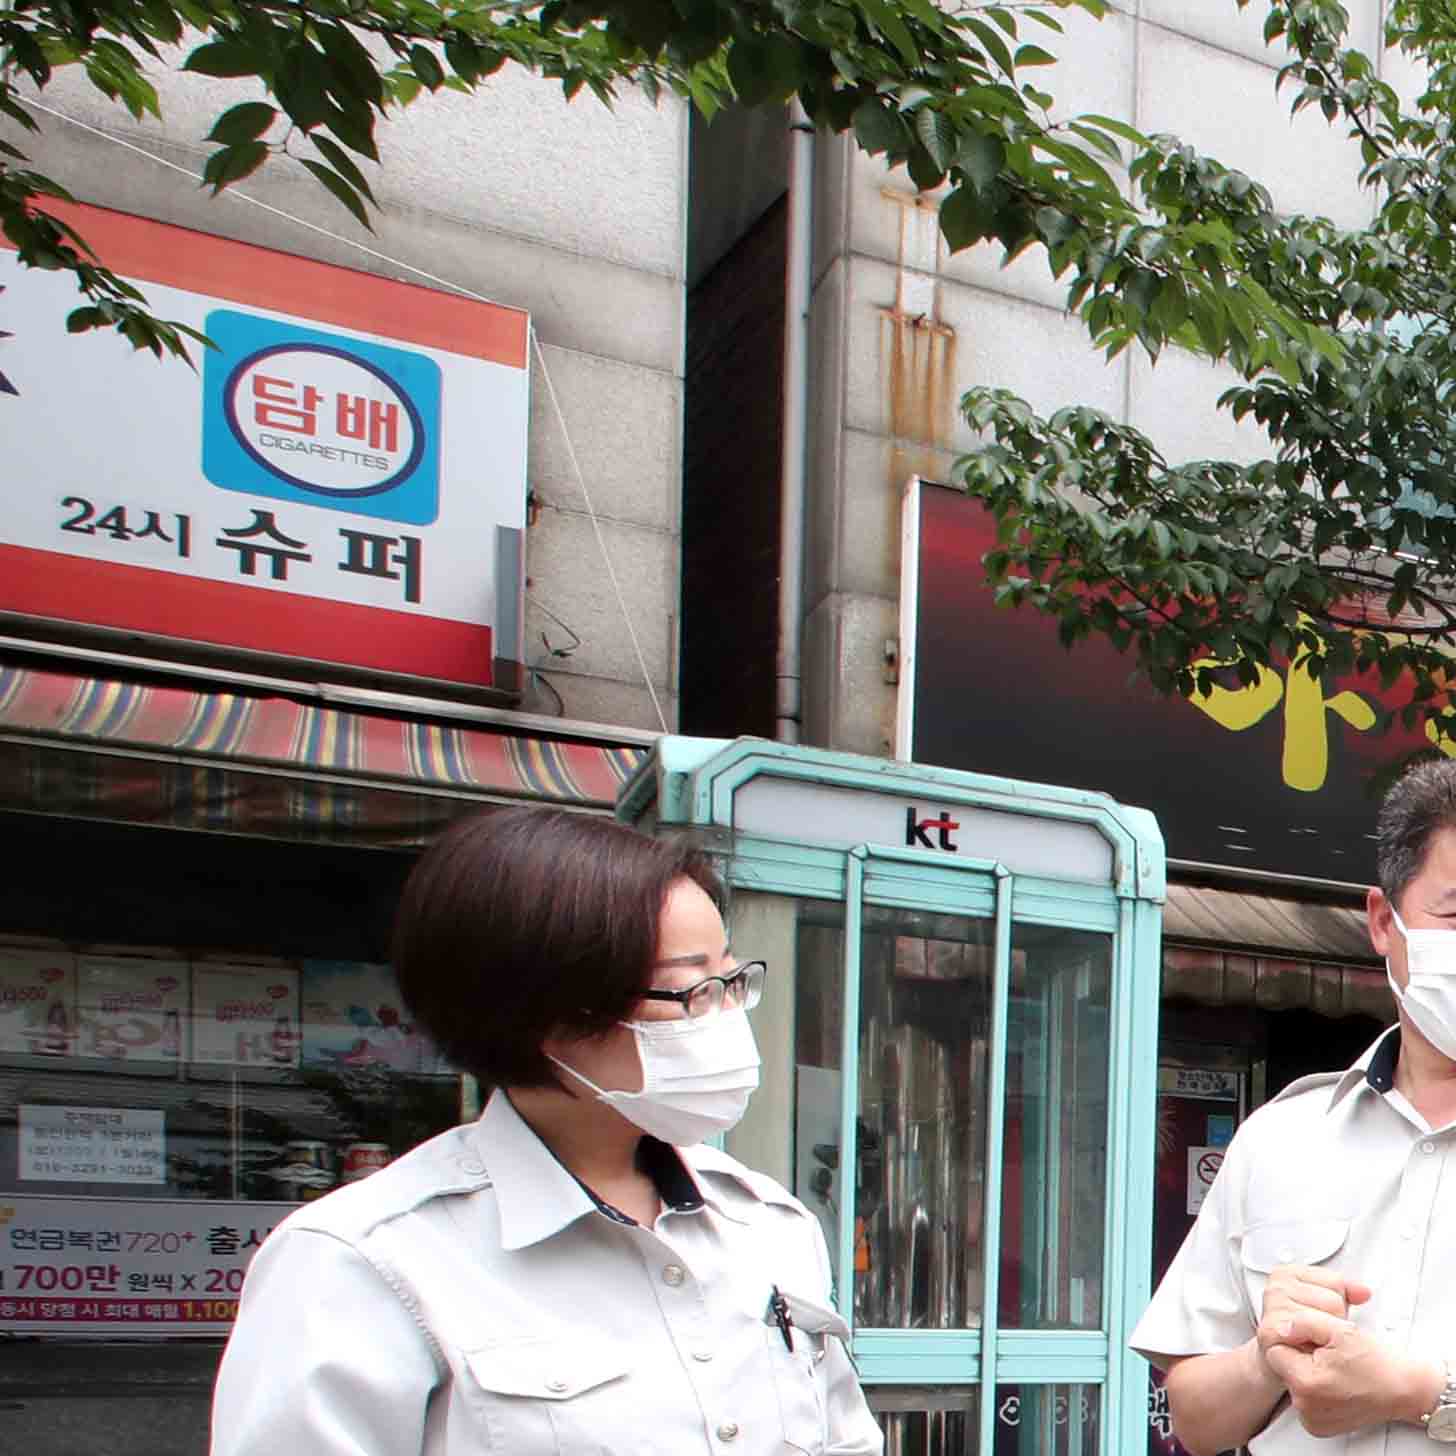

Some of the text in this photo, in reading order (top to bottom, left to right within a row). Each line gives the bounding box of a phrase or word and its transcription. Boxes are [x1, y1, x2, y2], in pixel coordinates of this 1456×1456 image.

[252, 373, 398, 453] 담배
[258, 432, 389, 472] CIGARETTES
[60, 496, 422, 604] 24시 슈퍼
[906, 807, 960, 851] kt
[13, 1264, 121, 1293] 700만
[128, 1272, 175, 1294] 원씩
